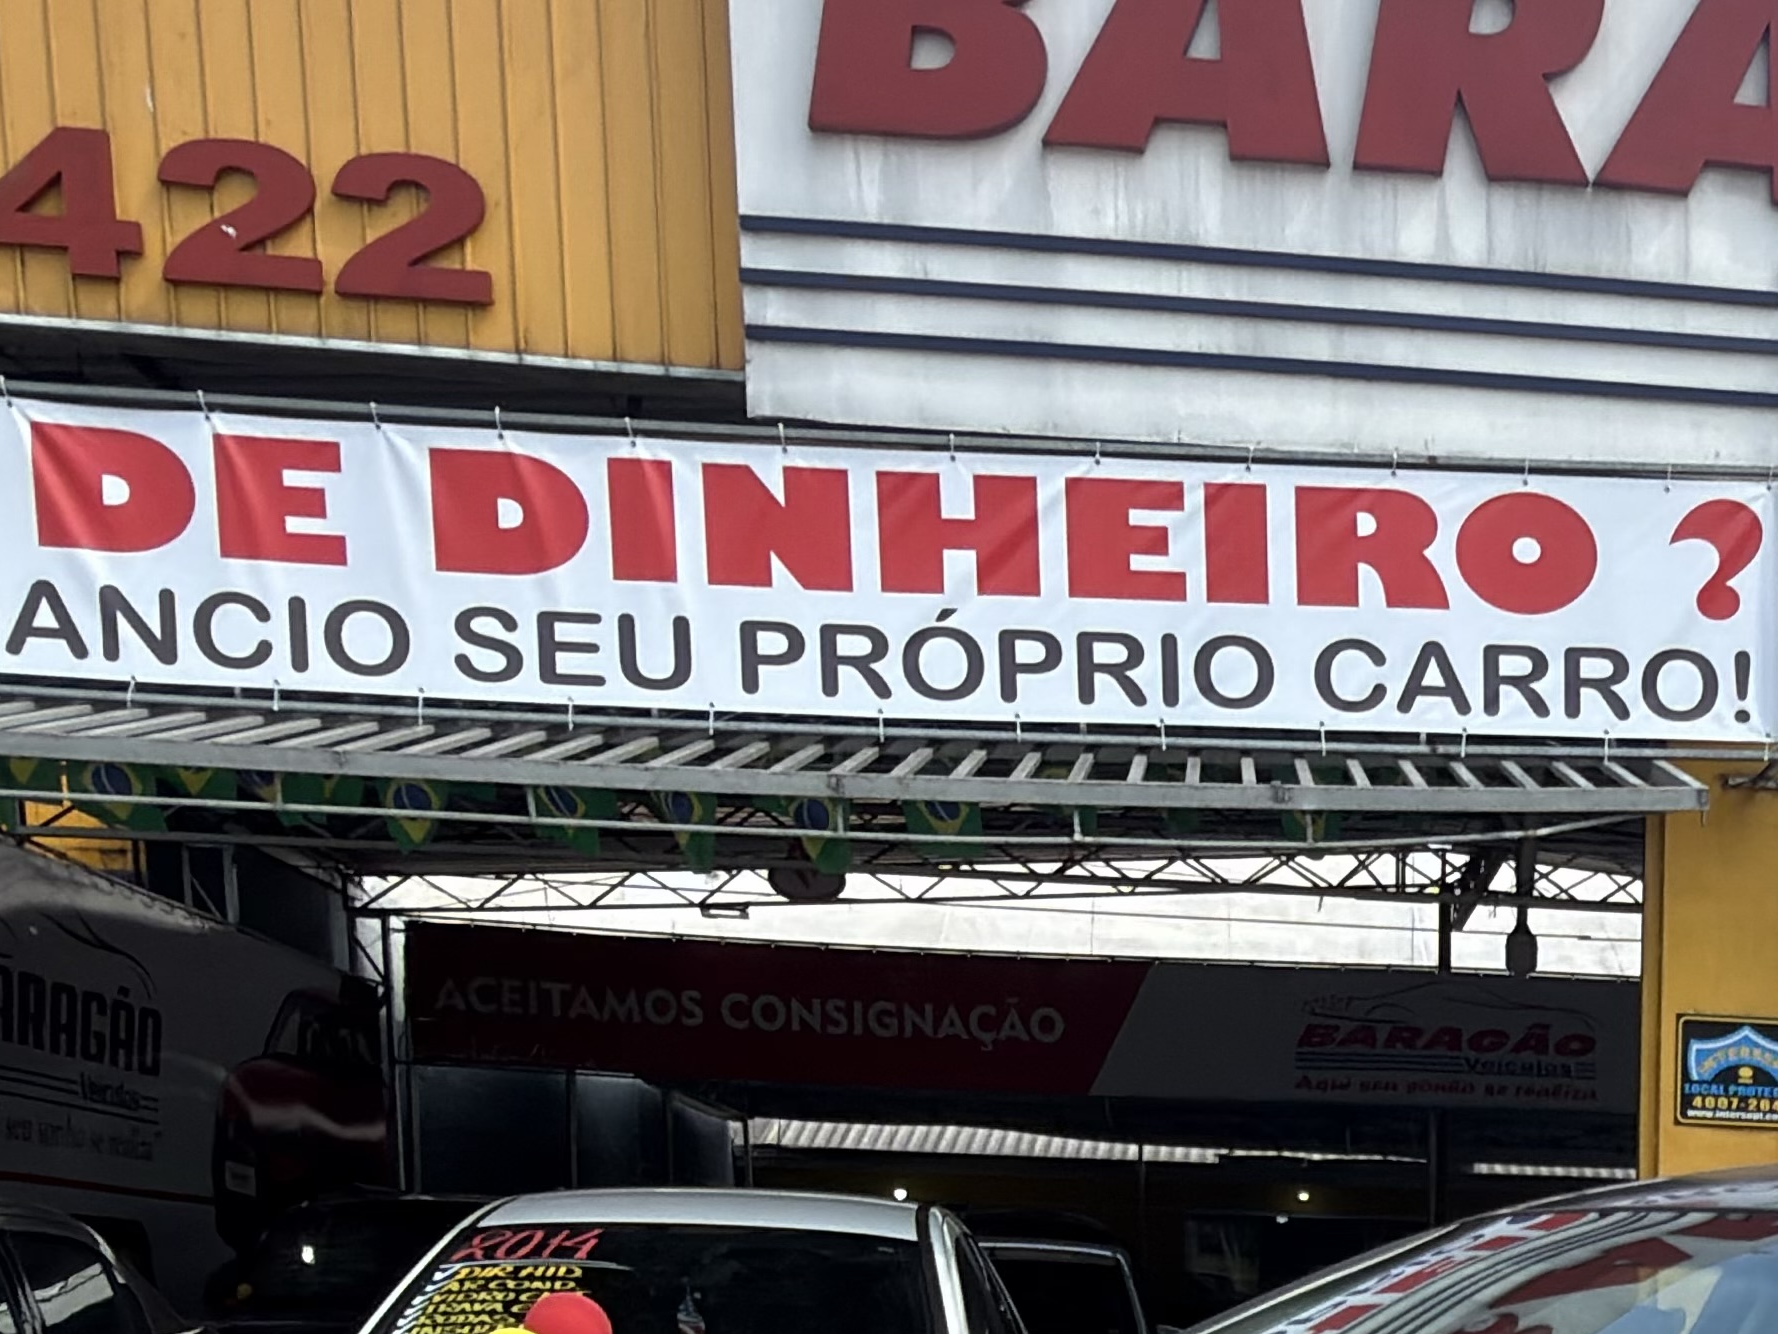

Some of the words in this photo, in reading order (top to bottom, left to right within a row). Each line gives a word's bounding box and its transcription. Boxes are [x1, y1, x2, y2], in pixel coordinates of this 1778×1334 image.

[30, 421, 349, 568] DE
[429, 446, 1599, 617] DINHEIRO
[1668, 497, 1765, 622] ?
[453, 605, 693, 692] SEU
[739, 608, 1276, 711] PRÓPRIO
[1313, 636, 1752, 726] CARRO!
[434, 976, 704, 1028] ACEITAMOS
[721, 993, 1067, 1050] CONSIGNAÇÃO
[1297, 1023, 1597, 1057] BARAGÃO
[1684, 1082, 1725, 1095] LOCAL
[450, 1227, 606, 1262] 2014
